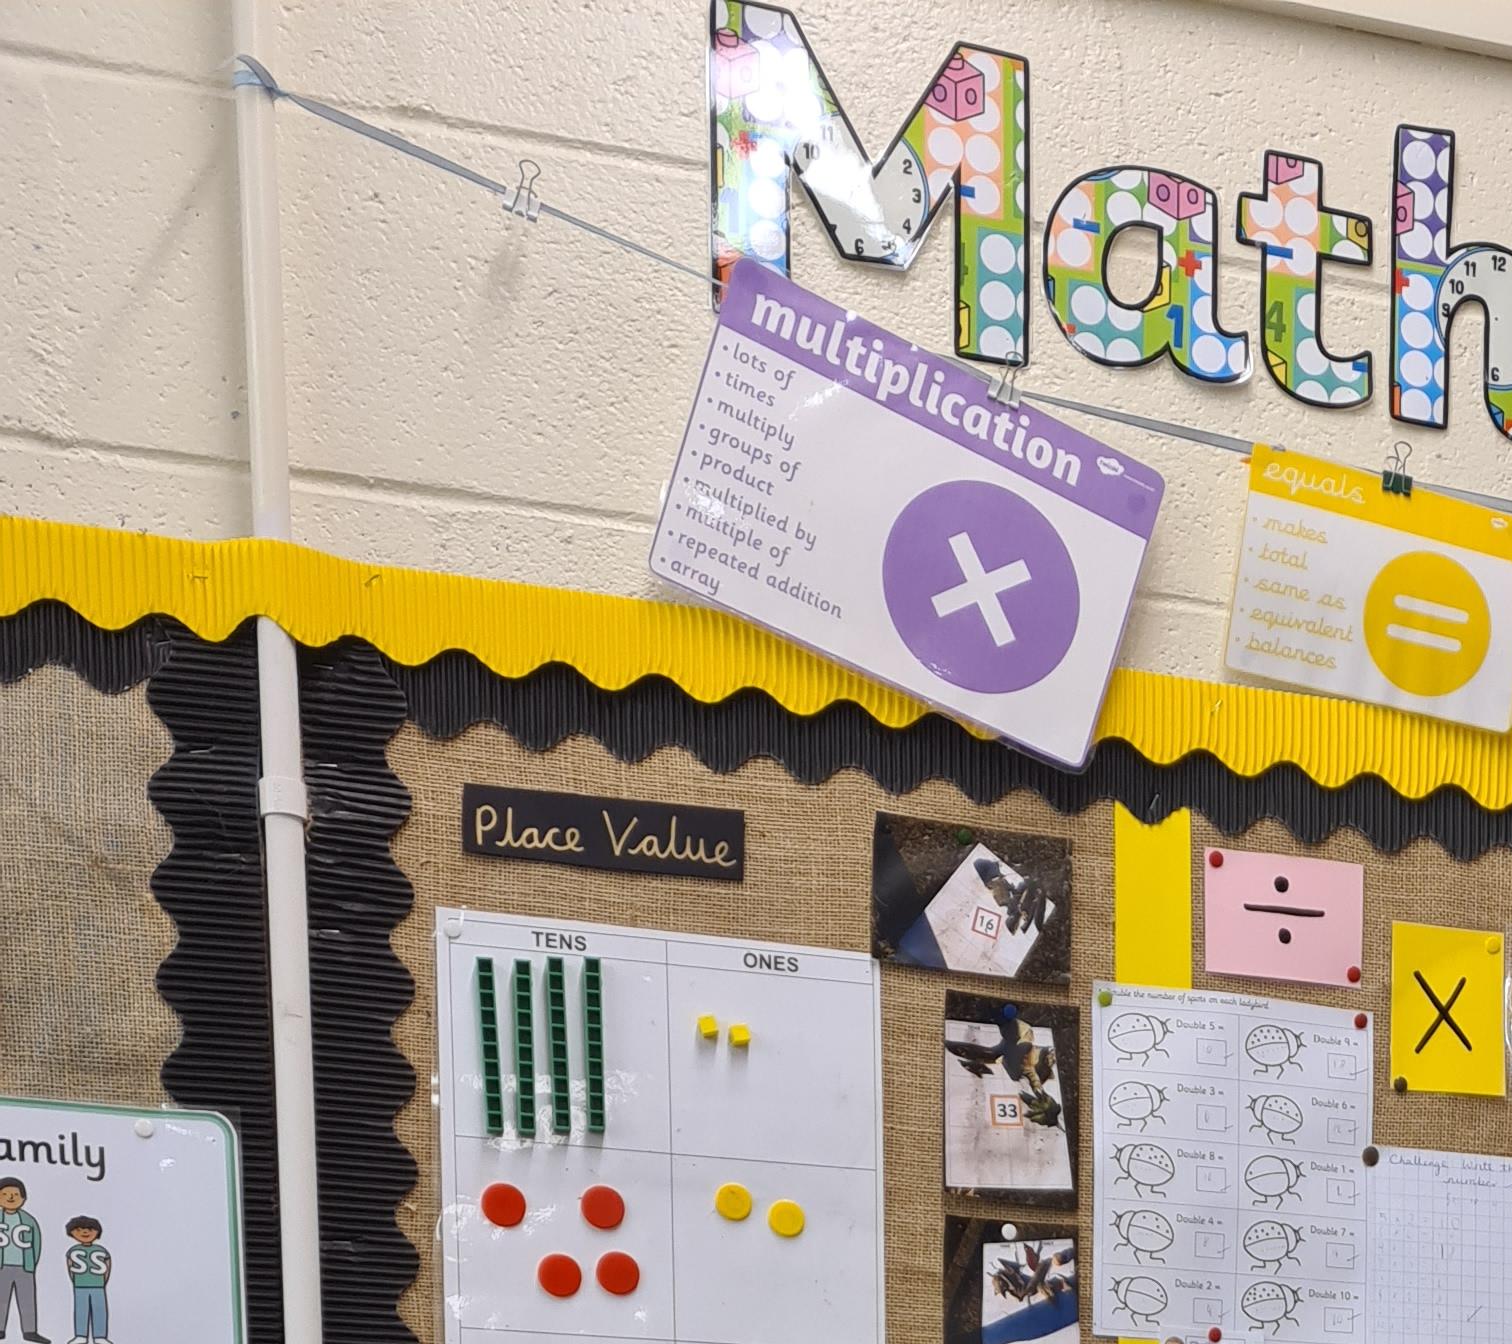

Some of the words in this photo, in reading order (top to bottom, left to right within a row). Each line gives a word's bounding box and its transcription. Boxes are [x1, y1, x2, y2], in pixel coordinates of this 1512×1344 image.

[724, 371, 776, 409] times
[750, 289, 1082, 486] multiplication
[716, 398, 796, 450] multiply
[700, 452, 776, 498] product
[1262, 461, 1365, 505] equals
[694, 480, 789, 534] multiplied
[795, 524, 818, 550] by
[669, 557, 720, 597] array
[678, 529, 760, 581] repeated
[766, 570, 843, 620] addition
[1258, 543, 1309, 571] total
[1248, 606, 1354, 644] equivalent
[1245, 634, 1338, 670] balances
[474, 805, 584, 853] Place
[603, 809, 737, 868] Value
[531, 930, 587, 952] TENS
[743, 952, 799, 973] ONES
